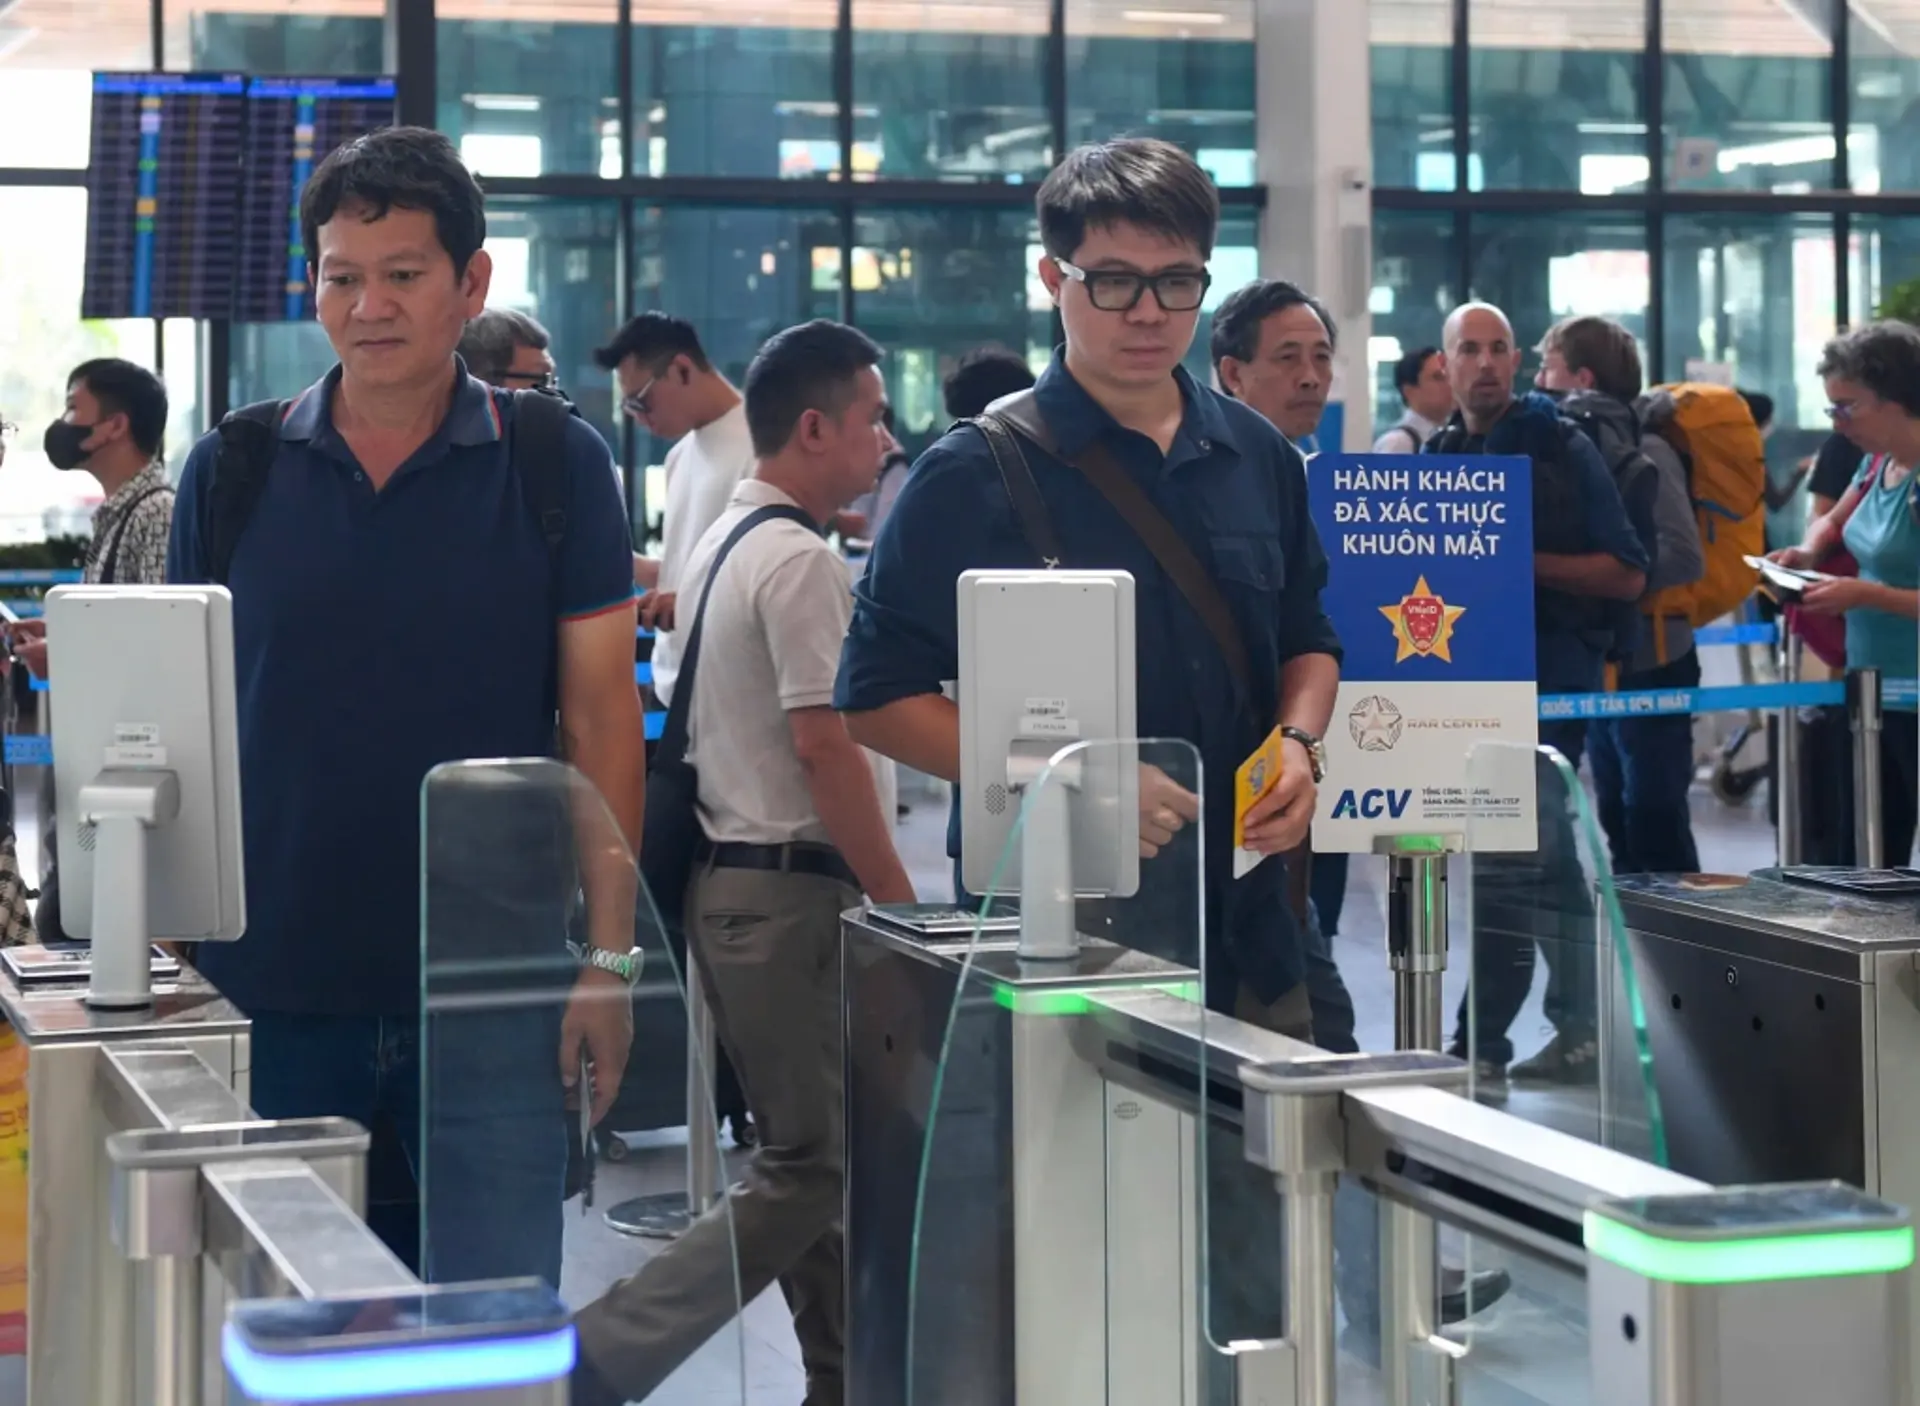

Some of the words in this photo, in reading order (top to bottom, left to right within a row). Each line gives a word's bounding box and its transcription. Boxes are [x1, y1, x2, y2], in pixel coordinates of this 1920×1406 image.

[1334, 464, 1410, 491] HÀNH
[1418, 465, 1506, 493] KHÁCH
[1334, 496, 1372, 523] ĐÃ
[1378, 496, 1429, 524] XÁC
[1436, 500, 1507, 528] THỰC
[1343, 528, 1436, 555] KHUÔN
[1444, 529, 1500, 560] MẶT
[1441, 718, 1501, 729] CENTER
[1331, 788, 1413, 819] ACV
